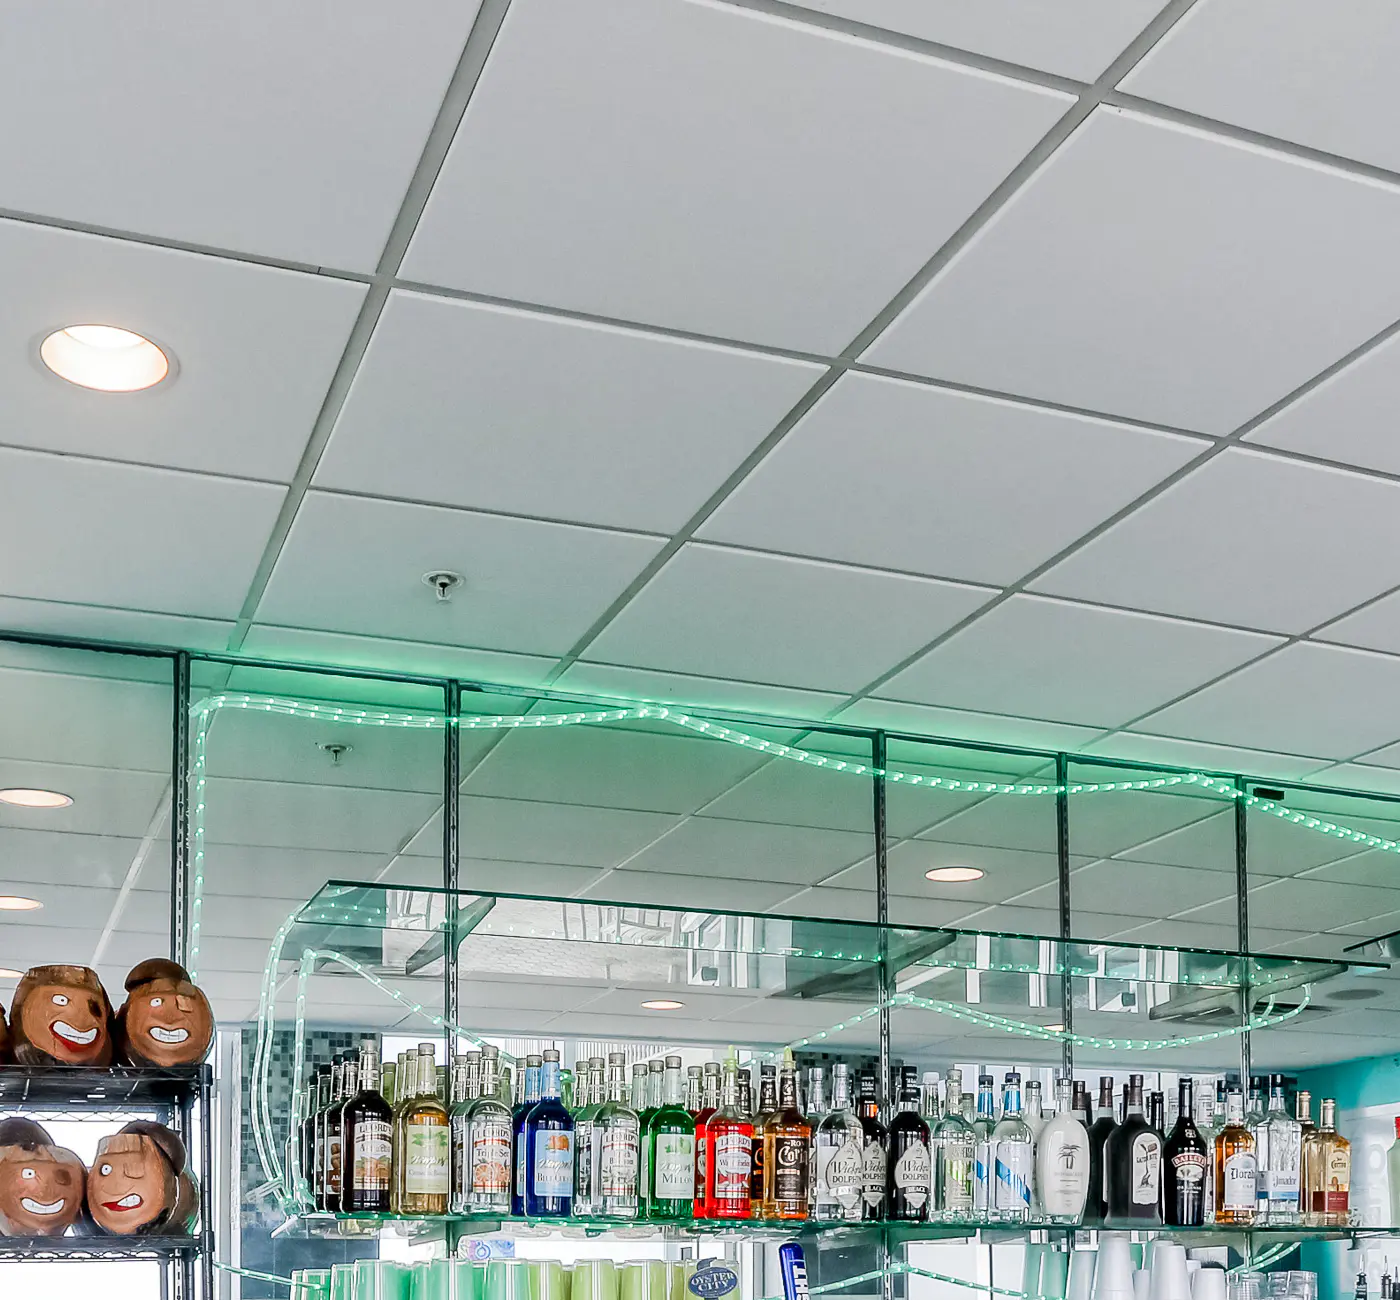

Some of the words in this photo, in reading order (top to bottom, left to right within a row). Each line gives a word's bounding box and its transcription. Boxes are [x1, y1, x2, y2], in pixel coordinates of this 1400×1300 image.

[1230, 1167, 1256, 1181] Dora
[691, 1272, 736, 1286] OYSTER
[697, 1279, 729, 1292] CITY
